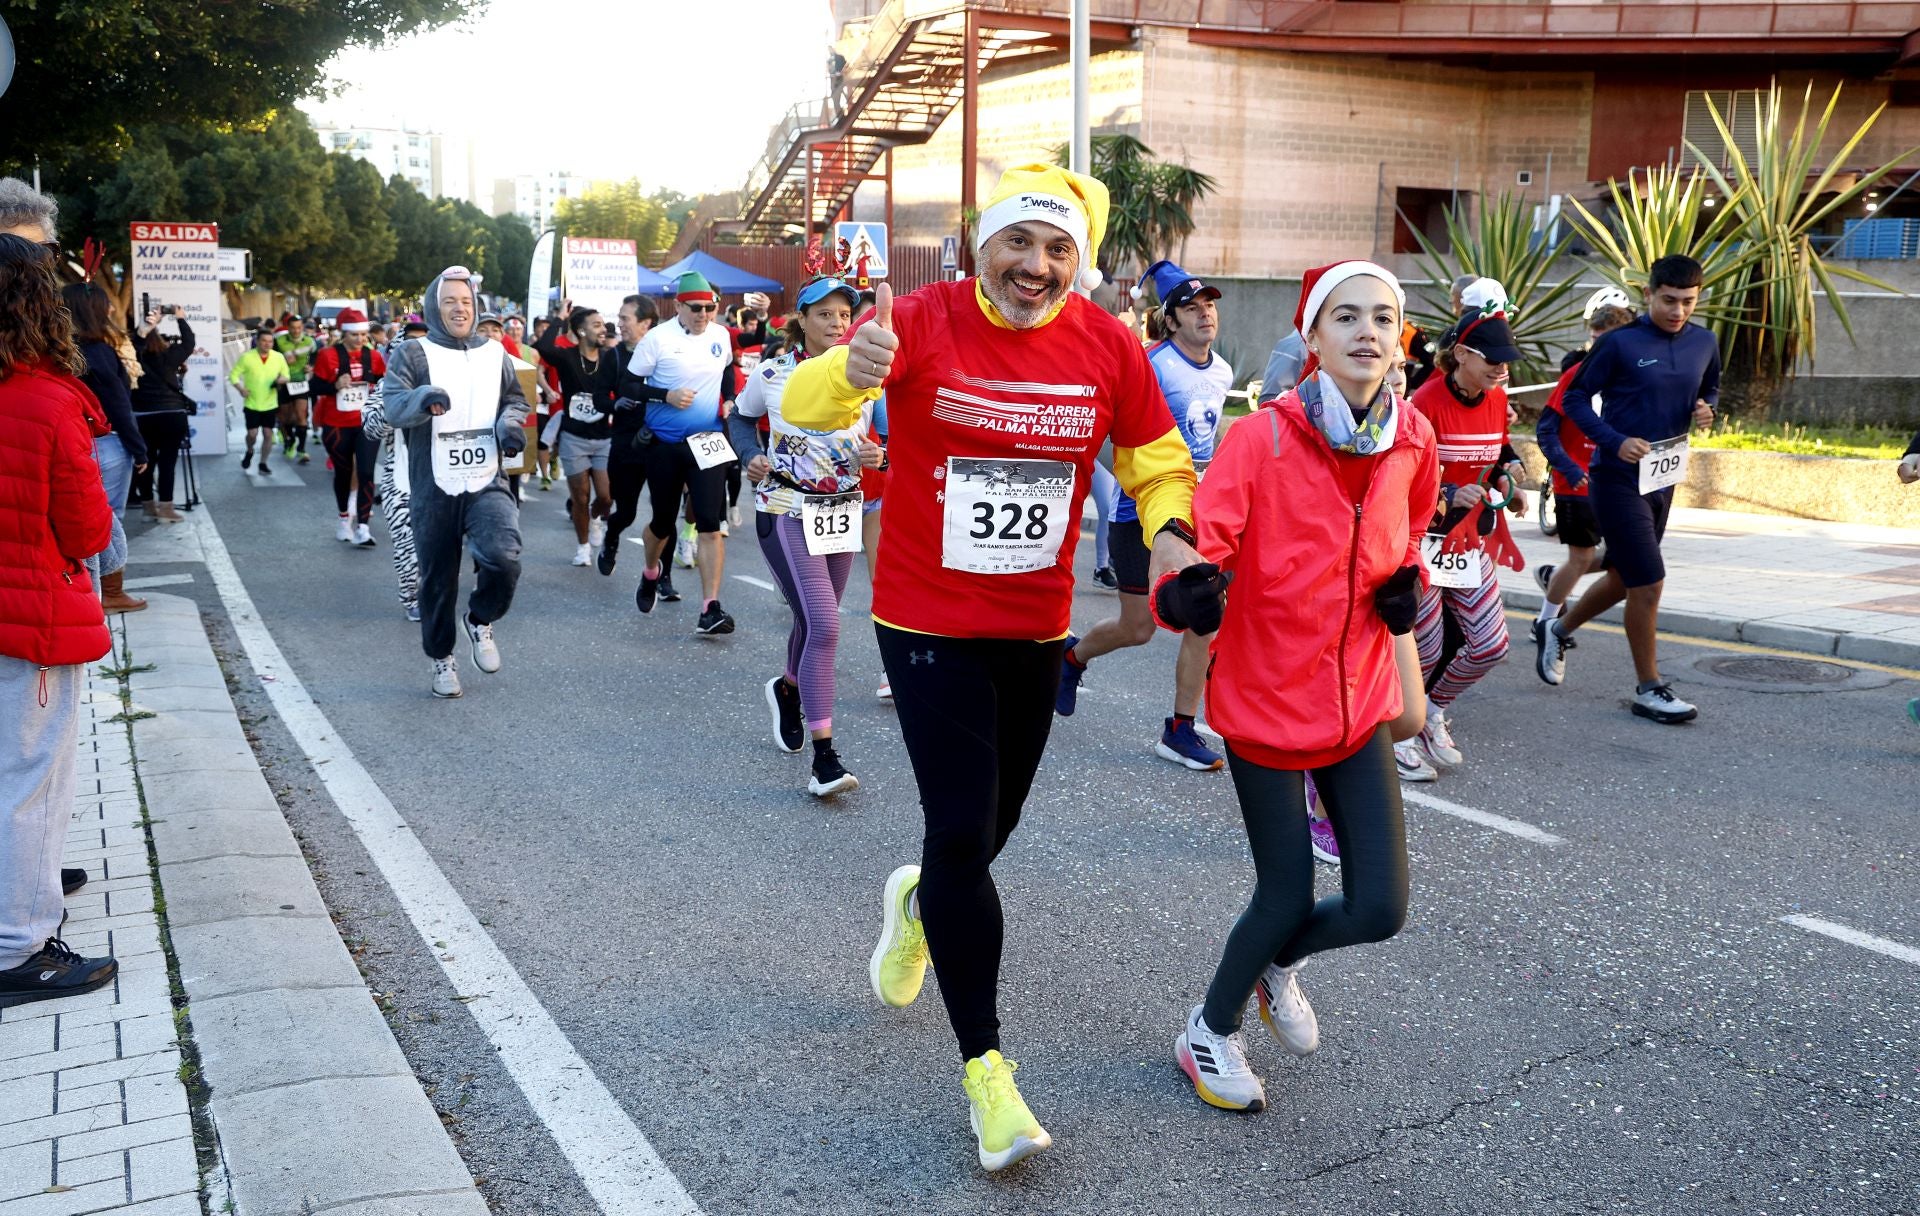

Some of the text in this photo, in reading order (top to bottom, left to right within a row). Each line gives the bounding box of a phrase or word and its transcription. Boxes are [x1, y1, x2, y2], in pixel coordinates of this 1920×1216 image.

[1031, 199, 1070, 214] weber
[135, 226, 214, 240] SALIDA
[137, 246, 168, 258] XIV
[569, 240, 633, 254] SALIDA
[142, 263, 161, 271] SAN
[164, 263, 211, 271] SILVESTRE
[570, 259, 595, 270] XIV
[136, 273, 168, 281] PALMA
[343, 393, 363, 402] 424
[1080, 385, 1097, 397] XIV
[1035, 404, 1096, 418] CARRERA
[977, 417, 1094, 438] PALMA PALMILLA
[1012, 414, 1095, 427] SAN SILVESTRE
[701, 439, 725, 456] 500
[1015, 443, 1041, 451] MÁLAGA
[448, 447, 486, 466] 509
[1650, 455, 1680, 477] 709
[1035, 477, 1072, 485] XIV
[814, 514, 850, 536] 813
[969, 502, 1049, 540] 328
[1431, 550, 1467, 570] 436
